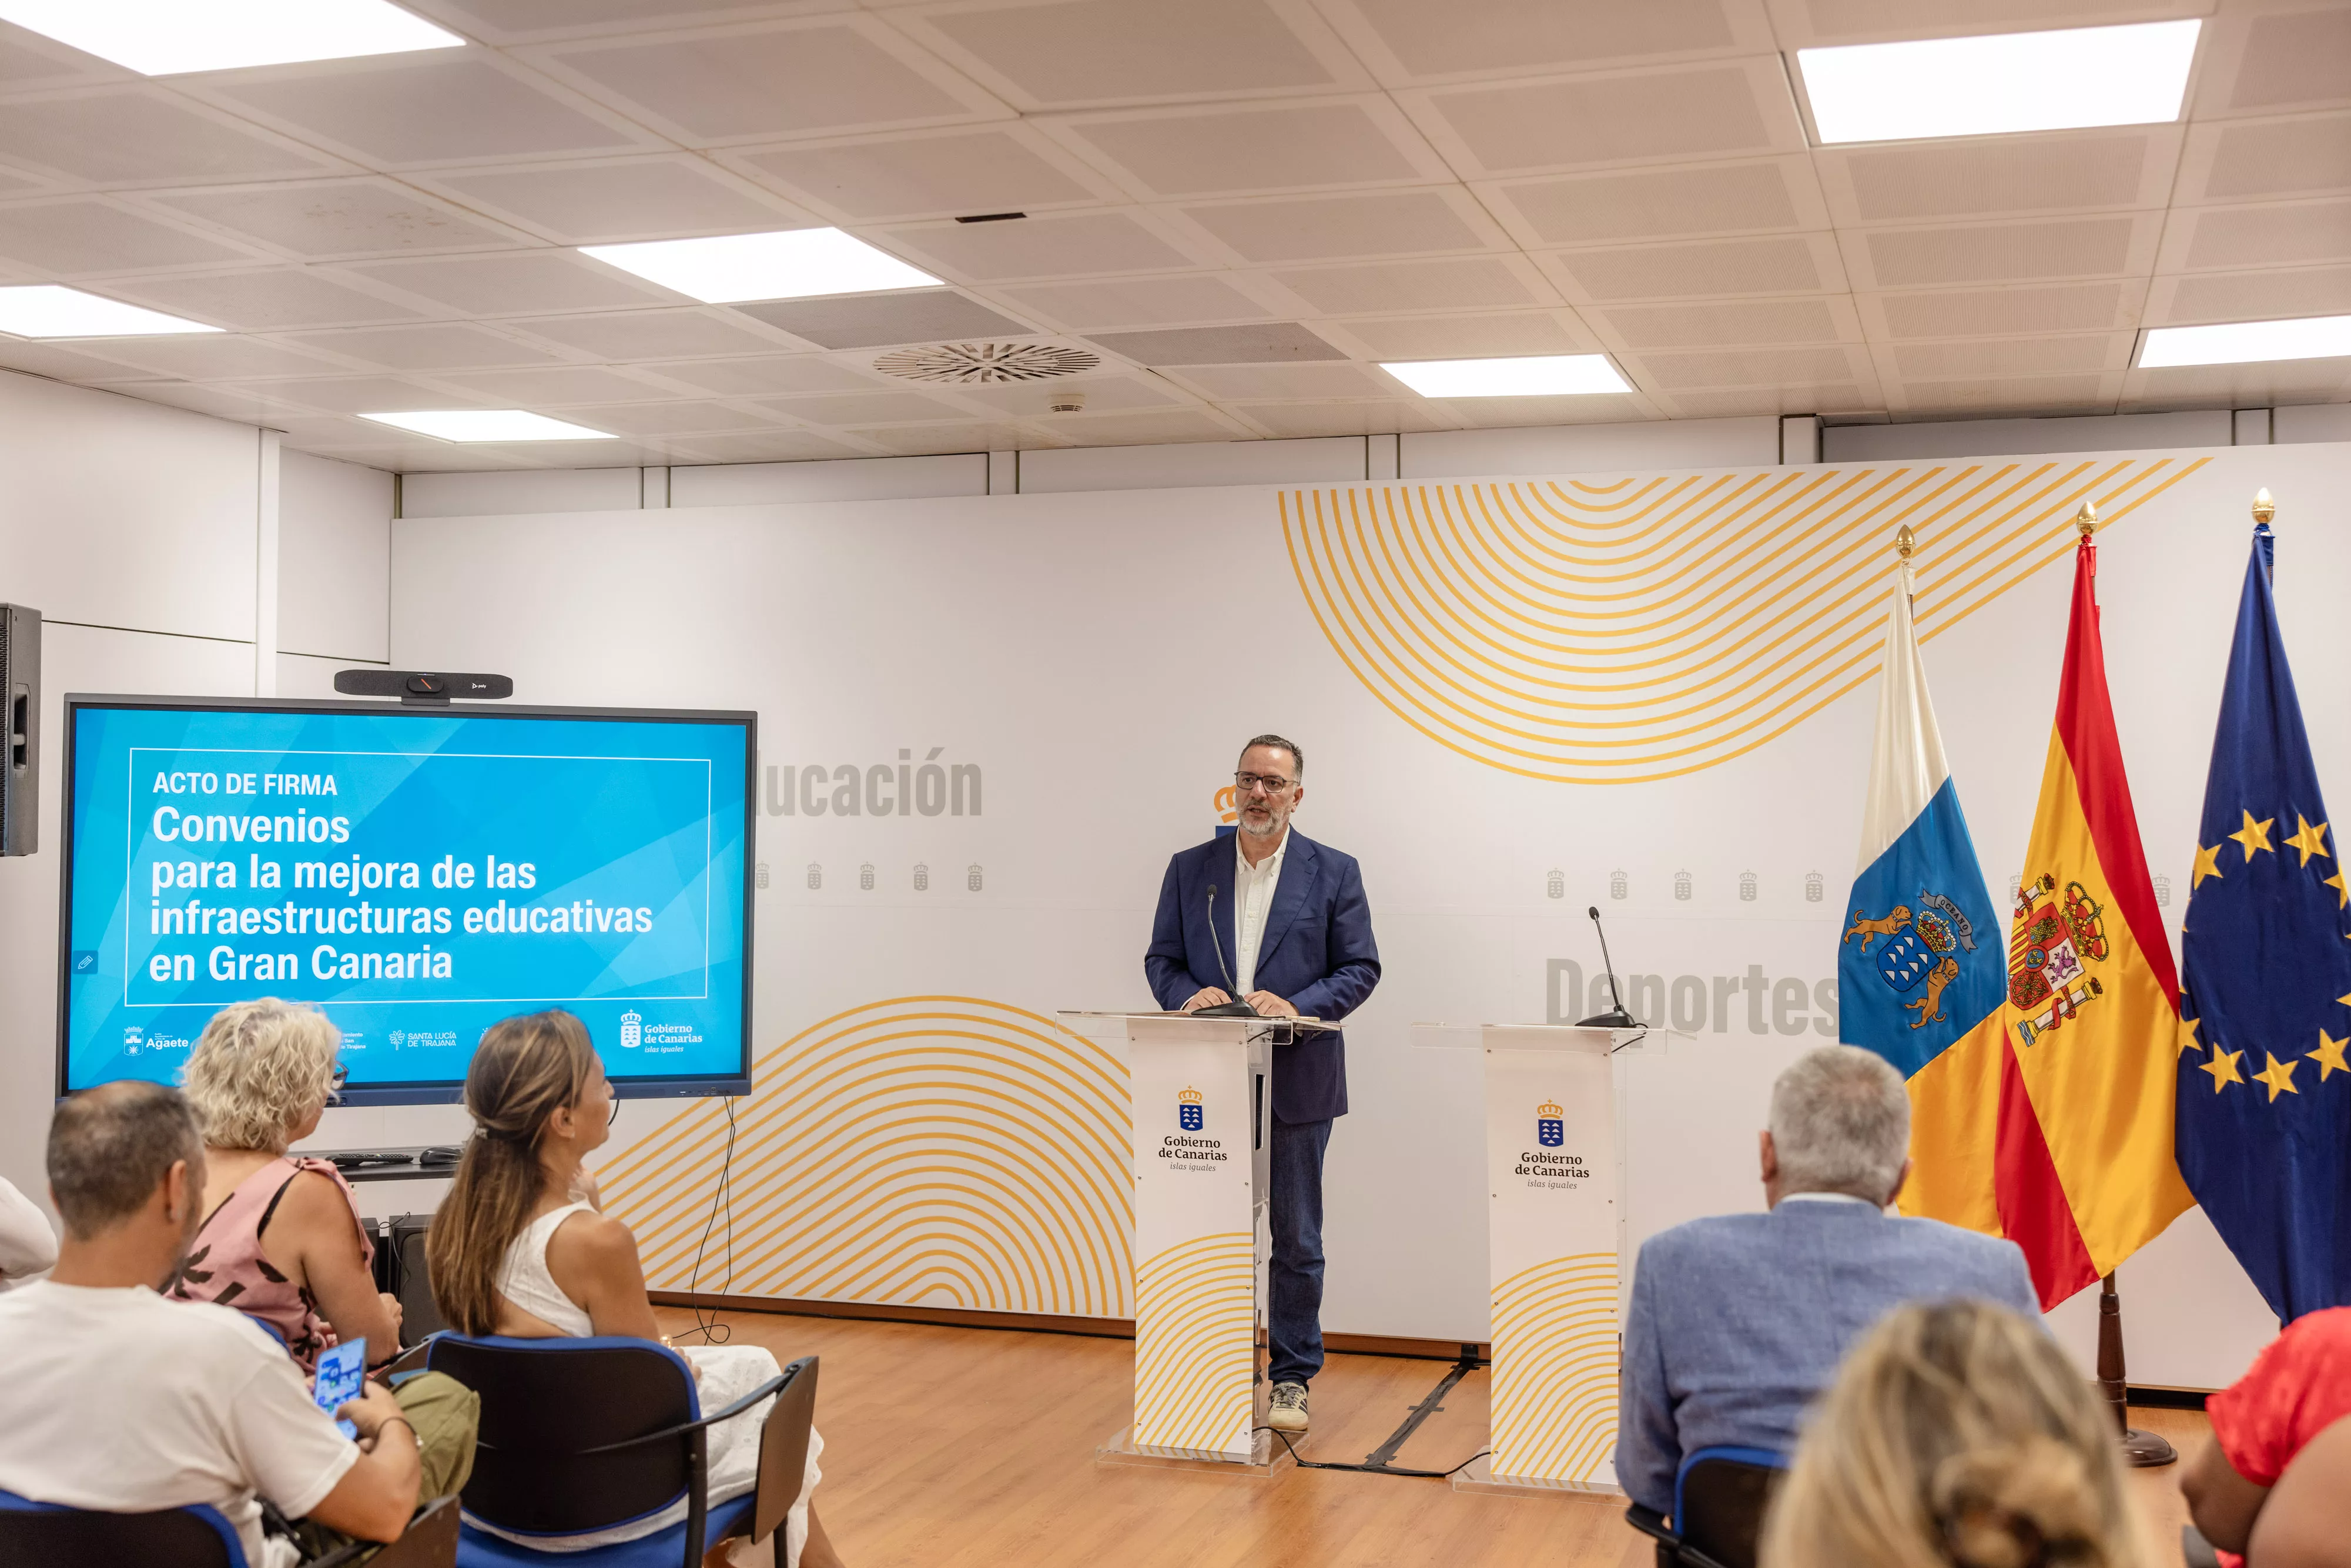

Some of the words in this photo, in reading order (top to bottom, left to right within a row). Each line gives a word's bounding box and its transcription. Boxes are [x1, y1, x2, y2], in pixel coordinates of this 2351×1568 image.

[153, 772, 218, 793] ACTO
[226, 773, 256, 794] DE
[264, 774, 338, 795] FIRMA
[756, 747, 982, 816] ucación
[153, 806, 350, 843] Convenios
[152, 861, 236, 897] para
[250, 854, 281, 888] la
[295, 854, 420, 897] mejora
[432, 855, 475, 888] de
[487, 855, 536, 889] las
[152, 899, 451, 934] infraestructuras
[464, 899, 652, 934] educativas
[1940, 899, 1968, 930] OCEANO
[150, 954, 195, 981] en
[209, 945, 298, 980] Gran
[312, 944, 452, 979] Canaria
[1546, 959, 1839, 1048] Deportes
[645, 1024, 692, 1033] Gobierno
[435, 1031, 457, 1040] LUCÍA
[644, 1034, 657, 1043] de
[658, 1034, 703, 1043] Canarias
[146, 1038, 189, 1050] Agaete
[1164, 1136, 1221, 1148] Gobierno
[1158, 1148, 1173, 1158] de
[1175, 1149, 1227, 1161] Canarias
[1521, 1152, 1582, 1165] Gobierno
[1189, 1163, 1216, 1172] iguales
[1515, 1164, 1530, 1175] de
[1532, 1165, 1589, 1178] Canarias
[1528, 1179, 1545, 1187] islas
[1548, 1180, 1578, 1190] iguales
